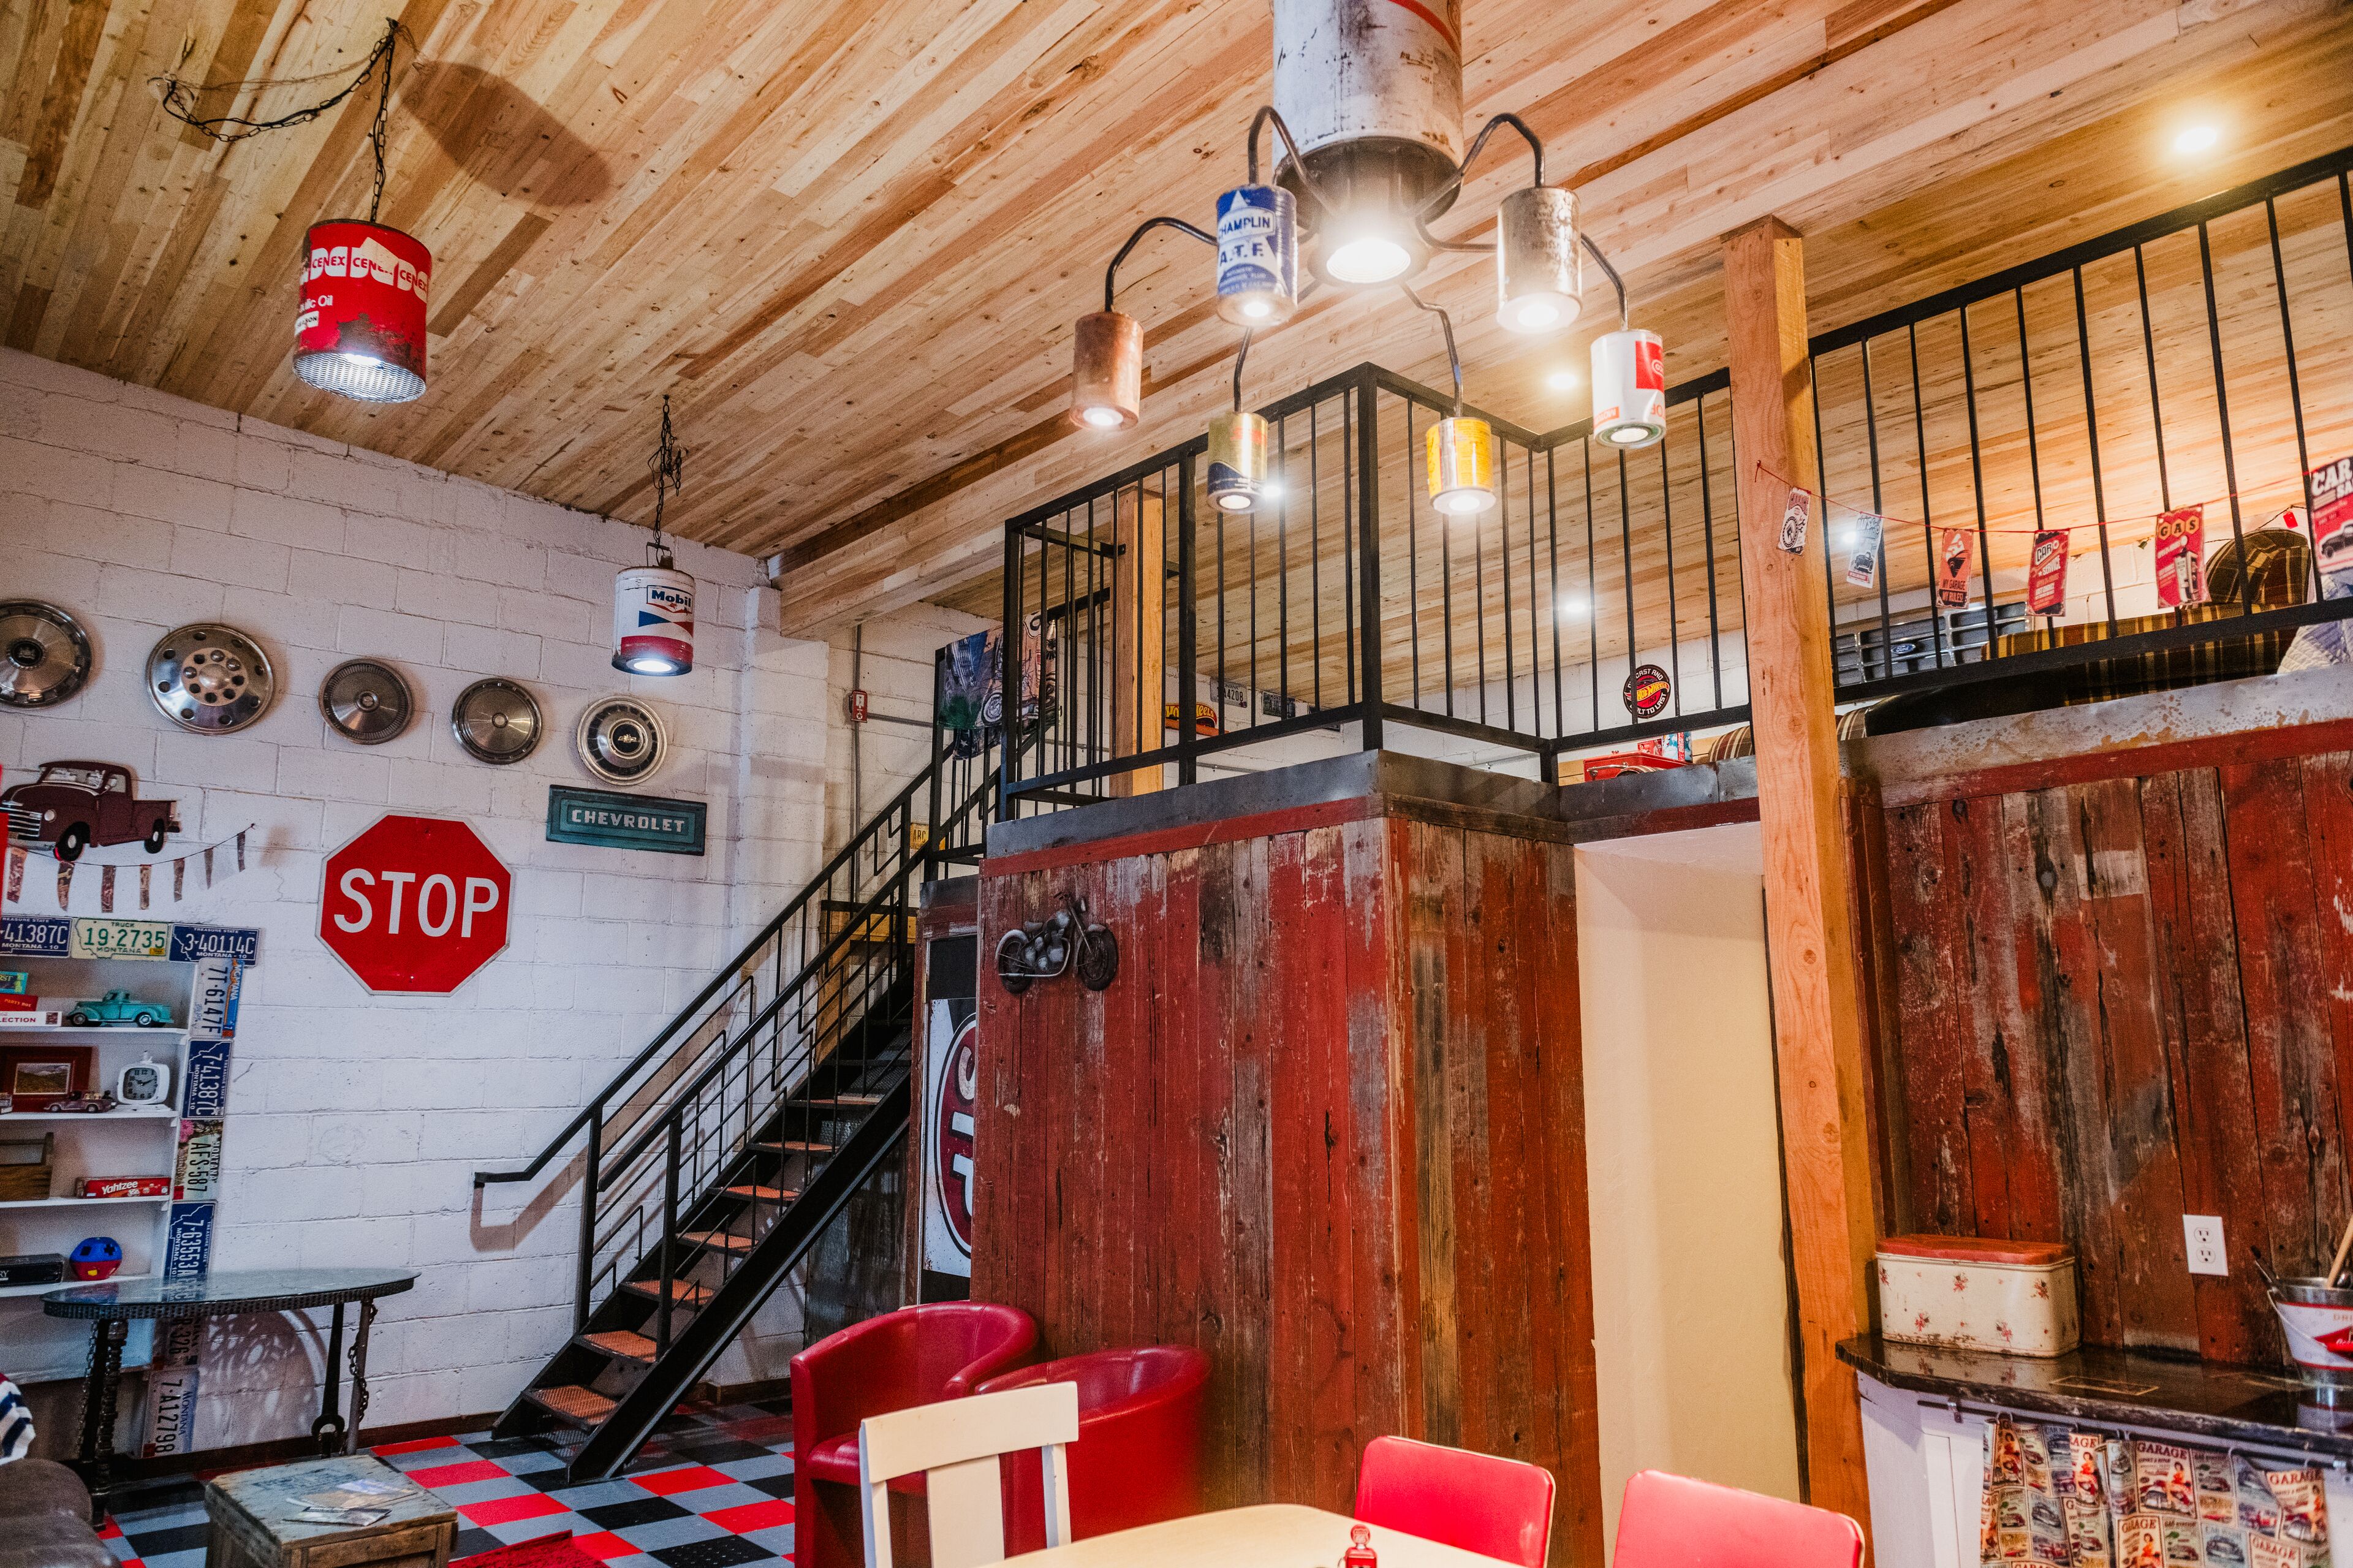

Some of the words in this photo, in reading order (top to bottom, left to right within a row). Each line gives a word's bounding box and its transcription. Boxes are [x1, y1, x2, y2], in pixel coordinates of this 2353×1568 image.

[312, 256, 346, 269] CENEX
[400, 270, 427, 292] CENEX
[317, 295, 333, 307] Oil
[2312, 458, 2353, 497] CAR
[2160, 520, 2197, 537] GAS
[2037, 543, 2052, 562] CAR
[1942, 579, 1949, 588] MY
[1949, 580, 1965, 590] GARAGE
[651, 589, 691, 607] Mobil
[1942, 591, 1949, 601] MY
[1651, 669, 1664, 681] AND
[1637, 687, 1648, 700] HOT
[1654, 692, 1667, 710] LAST
[572, 809, 685, 833] CHEVROLET
[912, 830, 926, 843] ABC
[334, 868, 499, 937] STOP
[230, 964, 243, 1001] MONTANA
[191, 1064, 200, 1097] MONTANA
[210, 1140, 221, 1181] MONTANA
[102, 1181, 138, 1194] Yahtzee
[172, 1227, 182, 1261] MONTANA
[171, 1265, 176, 1274] 10
[178, 1390, 194, 1436] MONTANA
[2137, 1442, 2187, 1460] GARAGE
[2253, 1536, 2295, 1560] GARAGE
